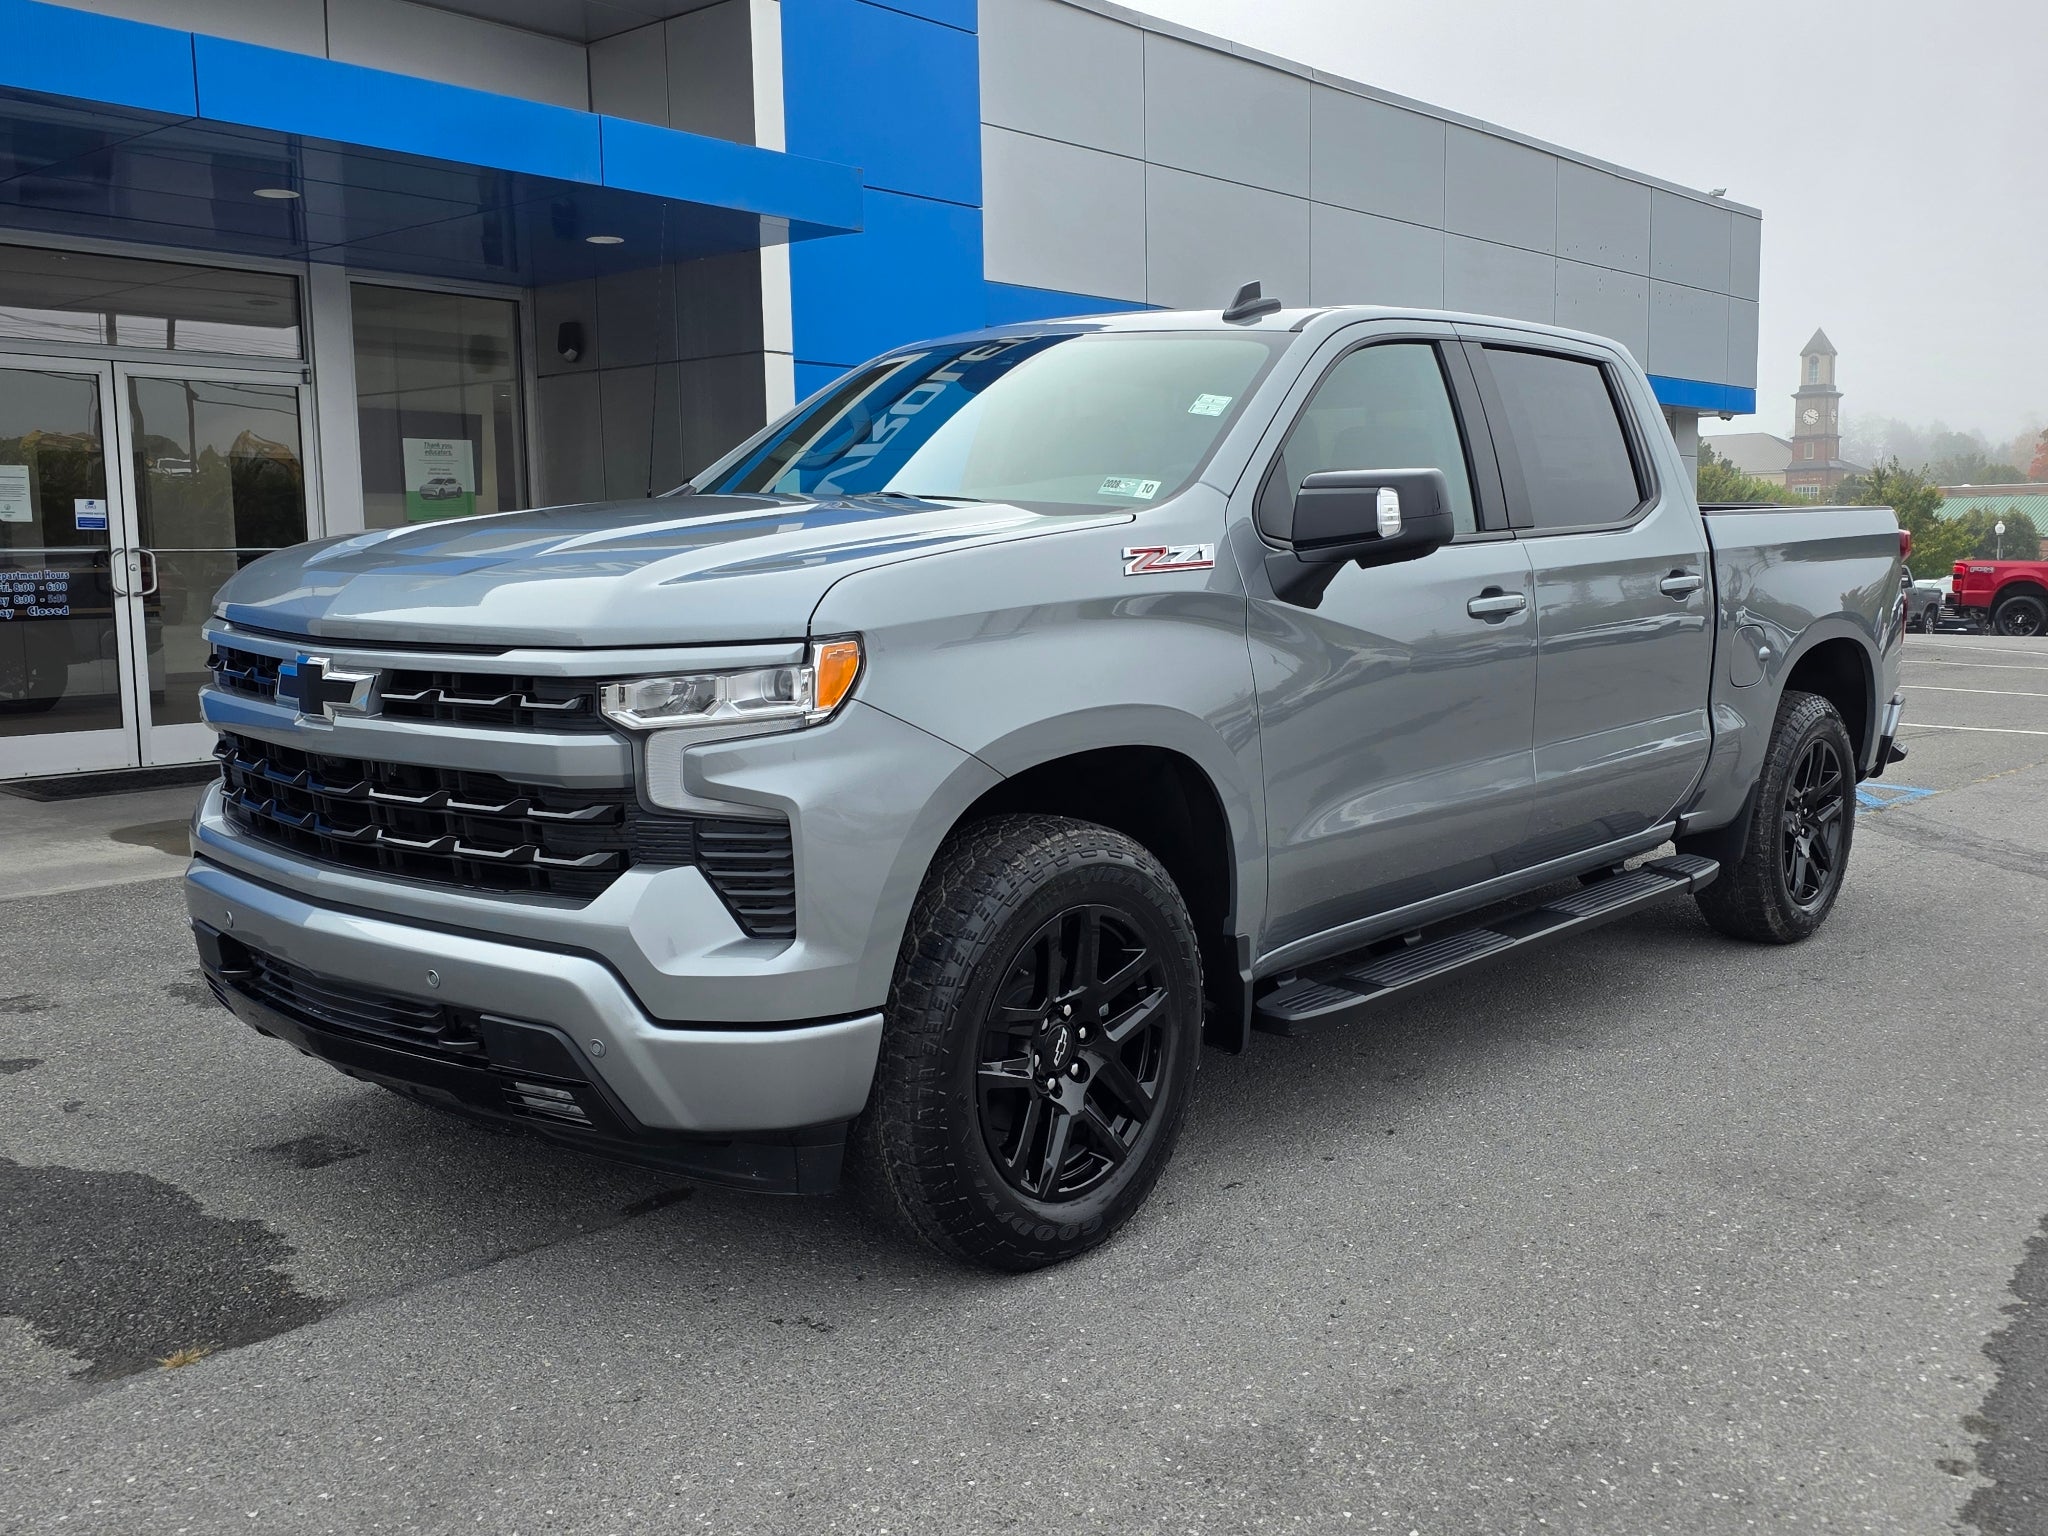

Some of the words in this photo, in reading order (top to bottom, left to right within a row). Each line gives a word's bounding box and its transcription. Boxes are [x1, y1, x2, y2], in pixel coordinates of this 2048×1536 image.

[1141, 483, 1155, 493] 10
[1121, 543, 1215, 576] Z71
[44, 570, 70, 580] Hours
[13, 582, 35, 592] 8:00
[46, 582, 68, 592] 6:00
[14, 595, 36, 604] 8:00
[27, 605, 70, 616] Closed
